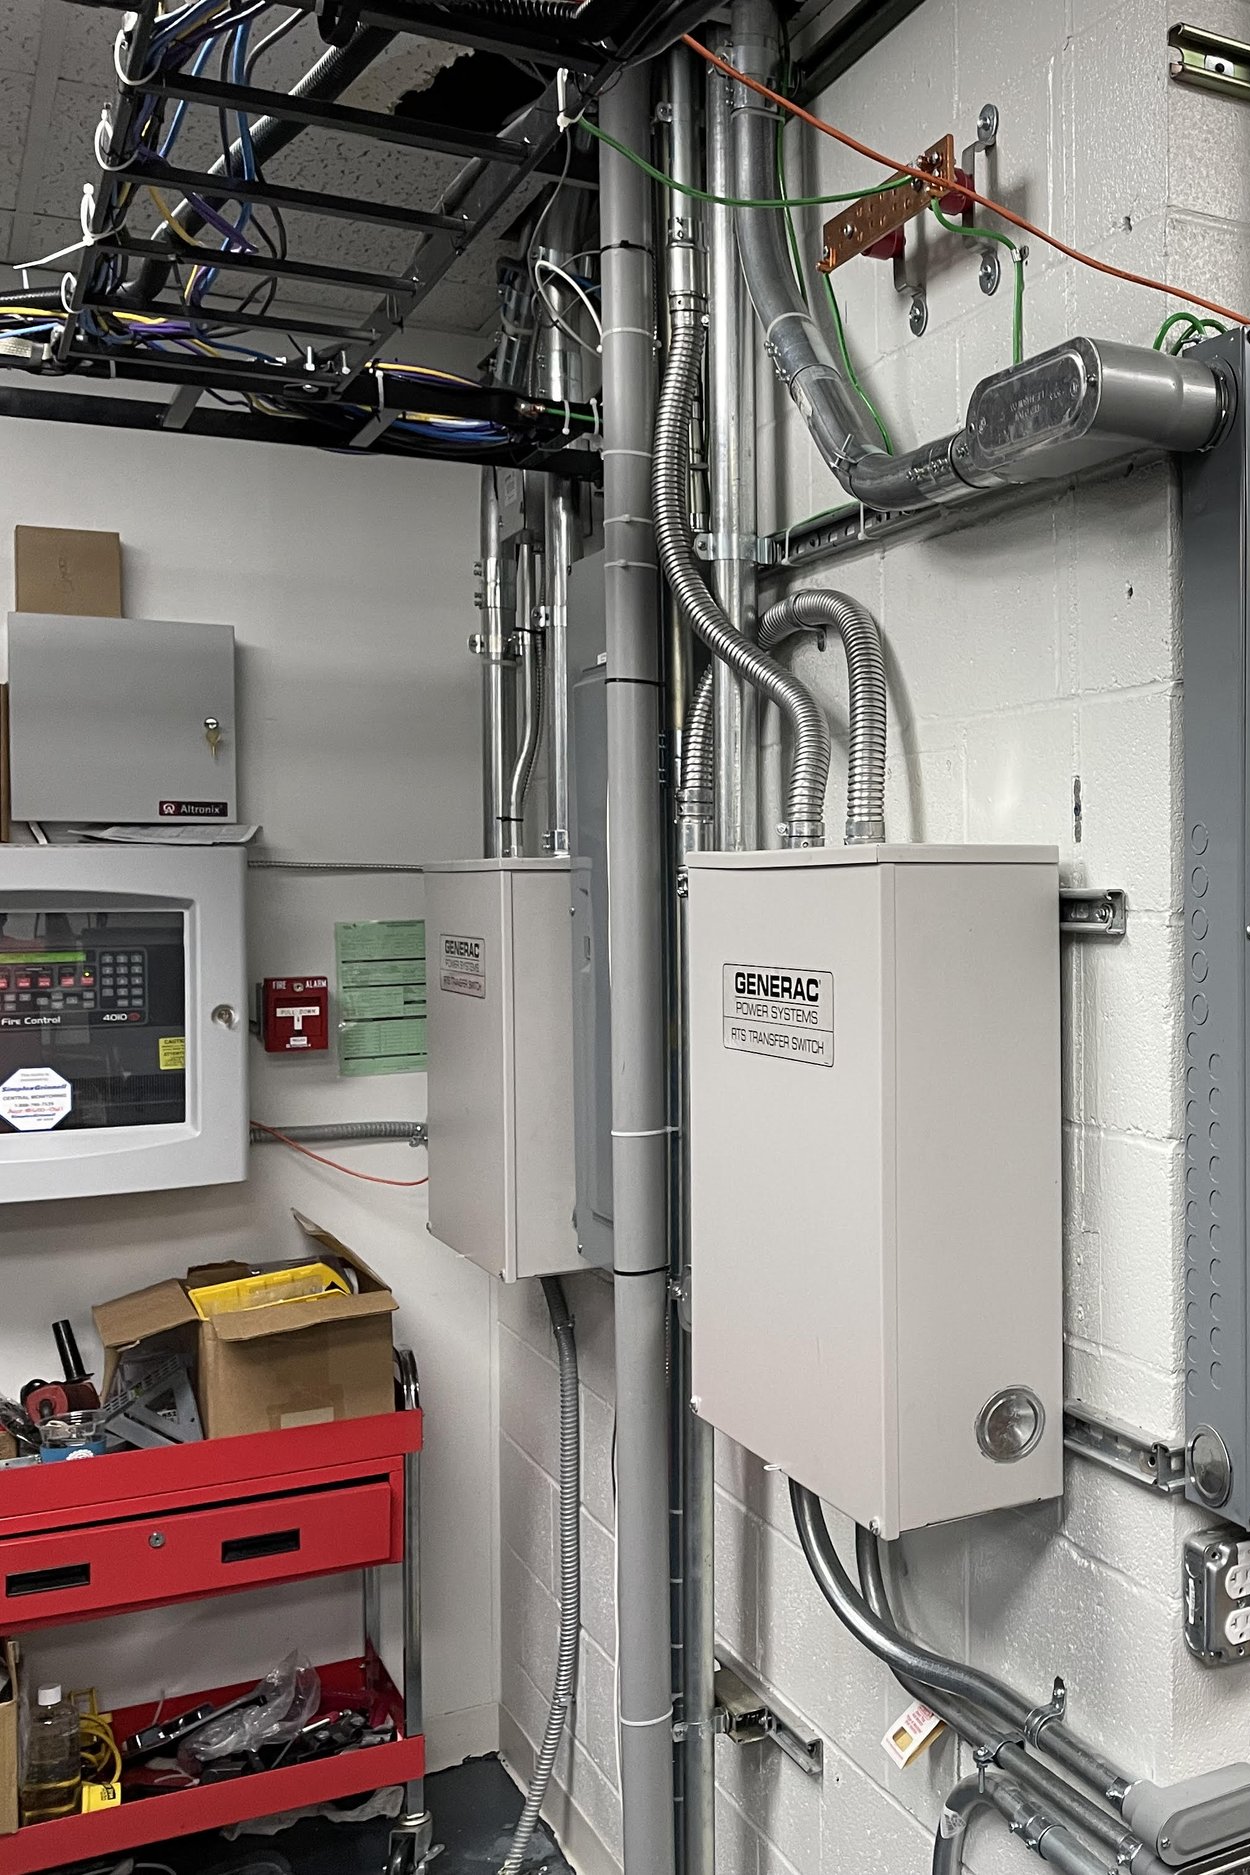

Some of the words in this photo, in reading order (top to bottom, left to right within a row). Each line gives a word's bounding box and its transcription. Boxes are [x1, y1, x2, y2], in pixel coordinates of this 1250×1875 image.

[180, 804, 220, 814] Altronix
[444, 939, 480, 959] GENERAC
[272, 980, 287, 990] FIRE
[305, 979, 328, 989] ALARM
[734, 971, 820, 1003] GENERAC
[102, 1013, 128, 1022] 4010
[736, 1001, 769, 1018] POWER
[770, 1005, 819, 1025] SYSTEMS
[1, 1017, 21, 1026] Fire
[24, 1016, 61, 1025] Control
[731, 1027, 747, 1042] RTS
[748, 1029, 790, 1049] TRANSFER
[791, 1036, 825, 1055] SWITCH
